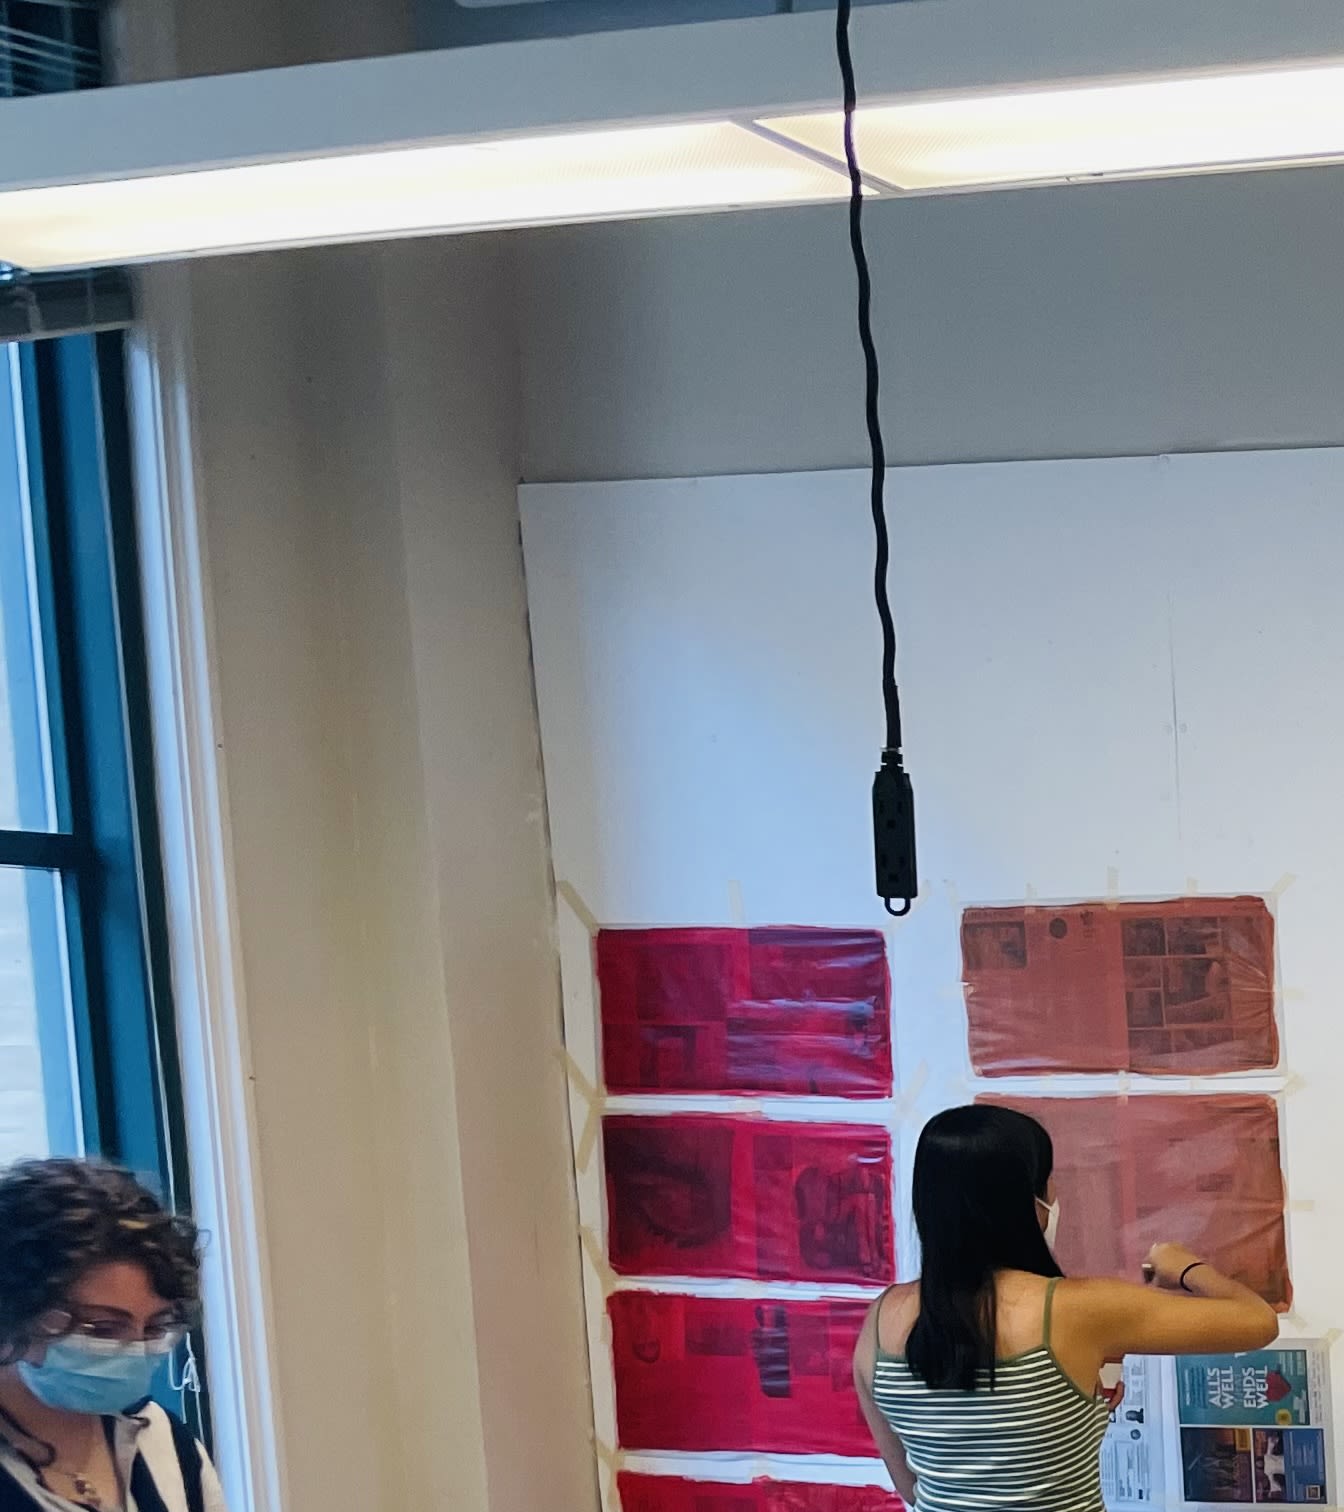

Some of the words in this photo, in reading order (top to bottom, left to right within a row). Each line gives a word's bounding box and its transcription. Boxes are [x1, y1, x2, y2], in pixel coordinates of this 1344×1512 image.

[1207, 1368, 1221, 1407] ALL'S
[1221, 1366, 1235, 1409] WELL
[1242, 1367, 1256, 1408] ENDS
[1256, 1365, 1269, 1409] WELL
